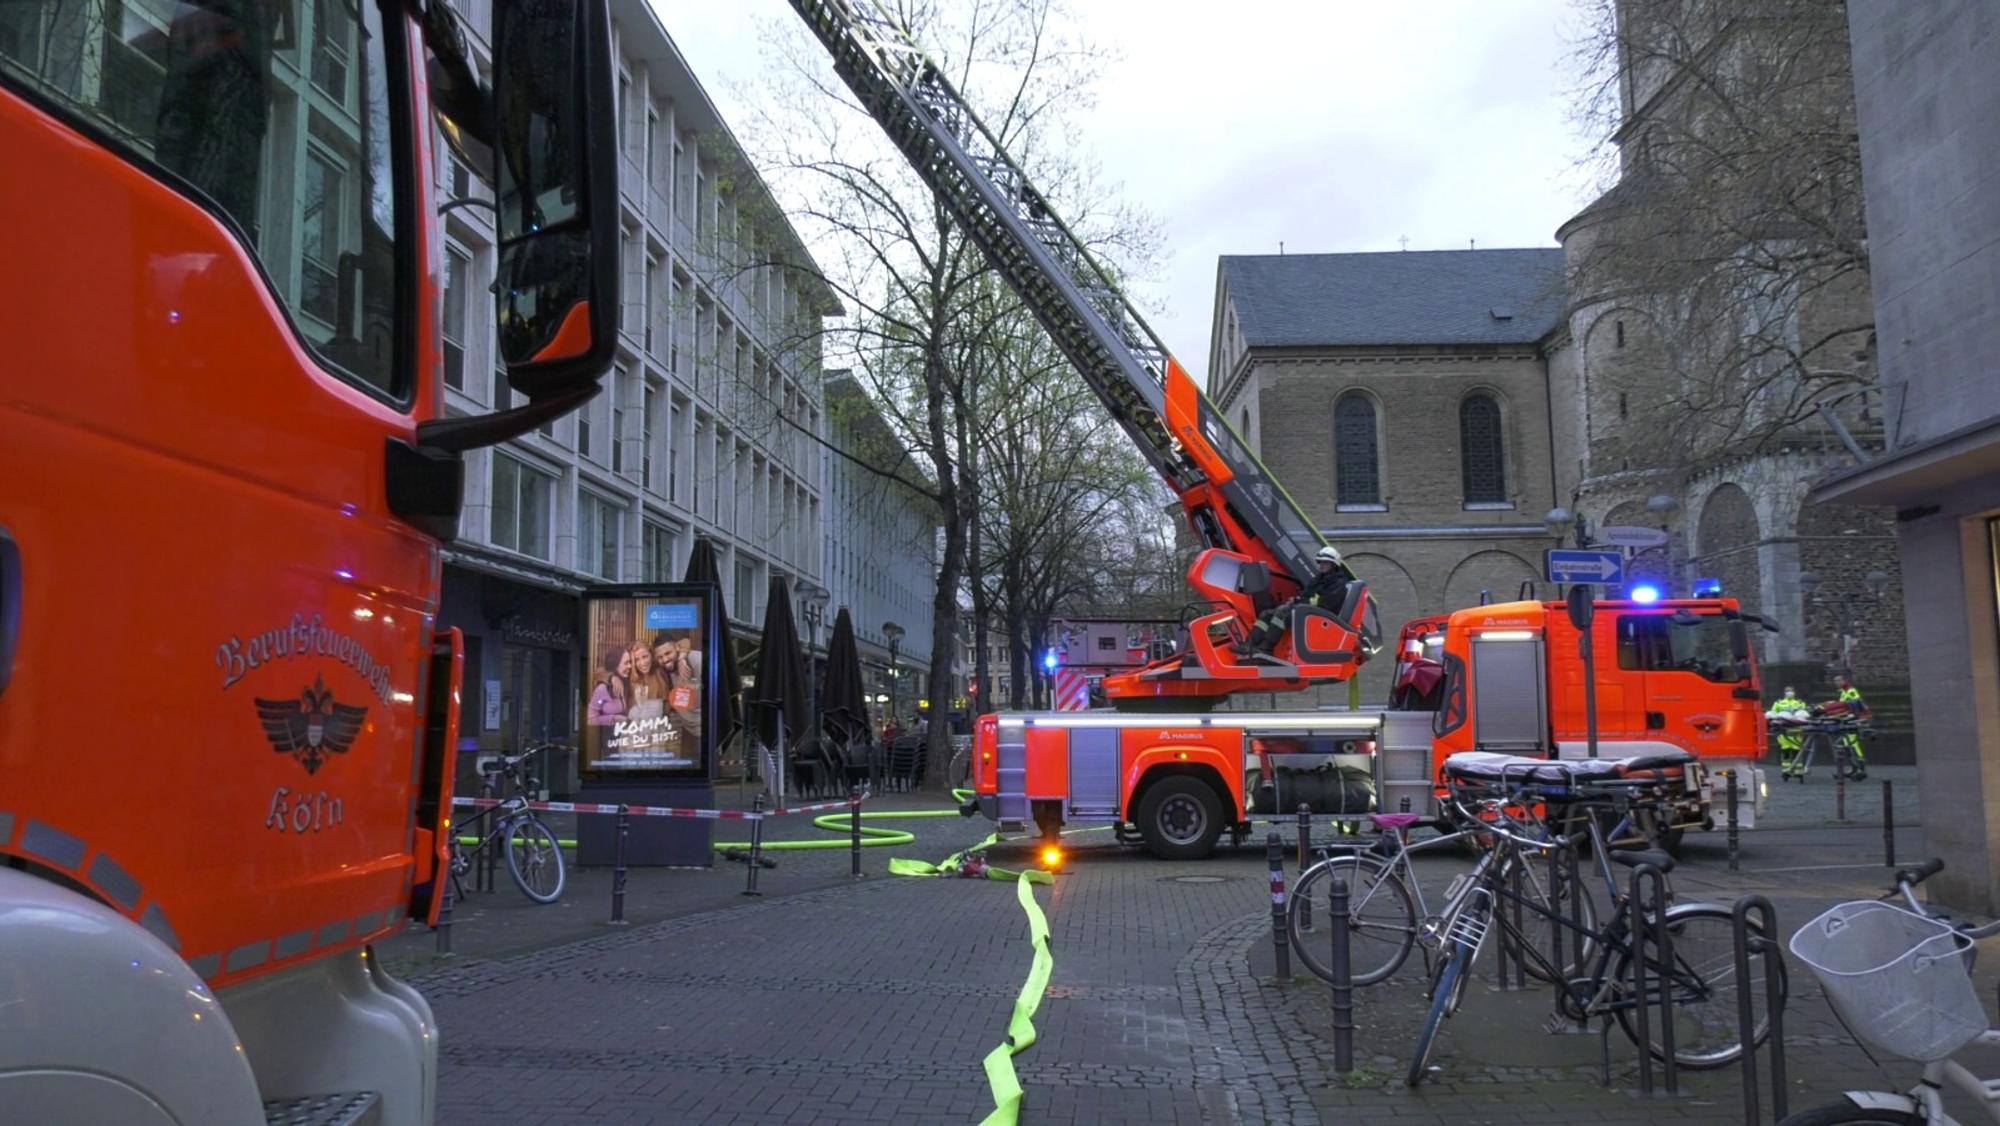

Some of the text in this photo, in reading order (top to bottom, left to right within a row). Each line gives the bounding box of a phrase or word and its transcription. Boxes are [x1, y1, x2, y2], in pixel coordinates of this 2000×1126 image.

[613, 715, 672, 737] KOMM,
[607, 731, 678, 748] WIE DU BIST.
[266, 785, 344, 833] Köln
